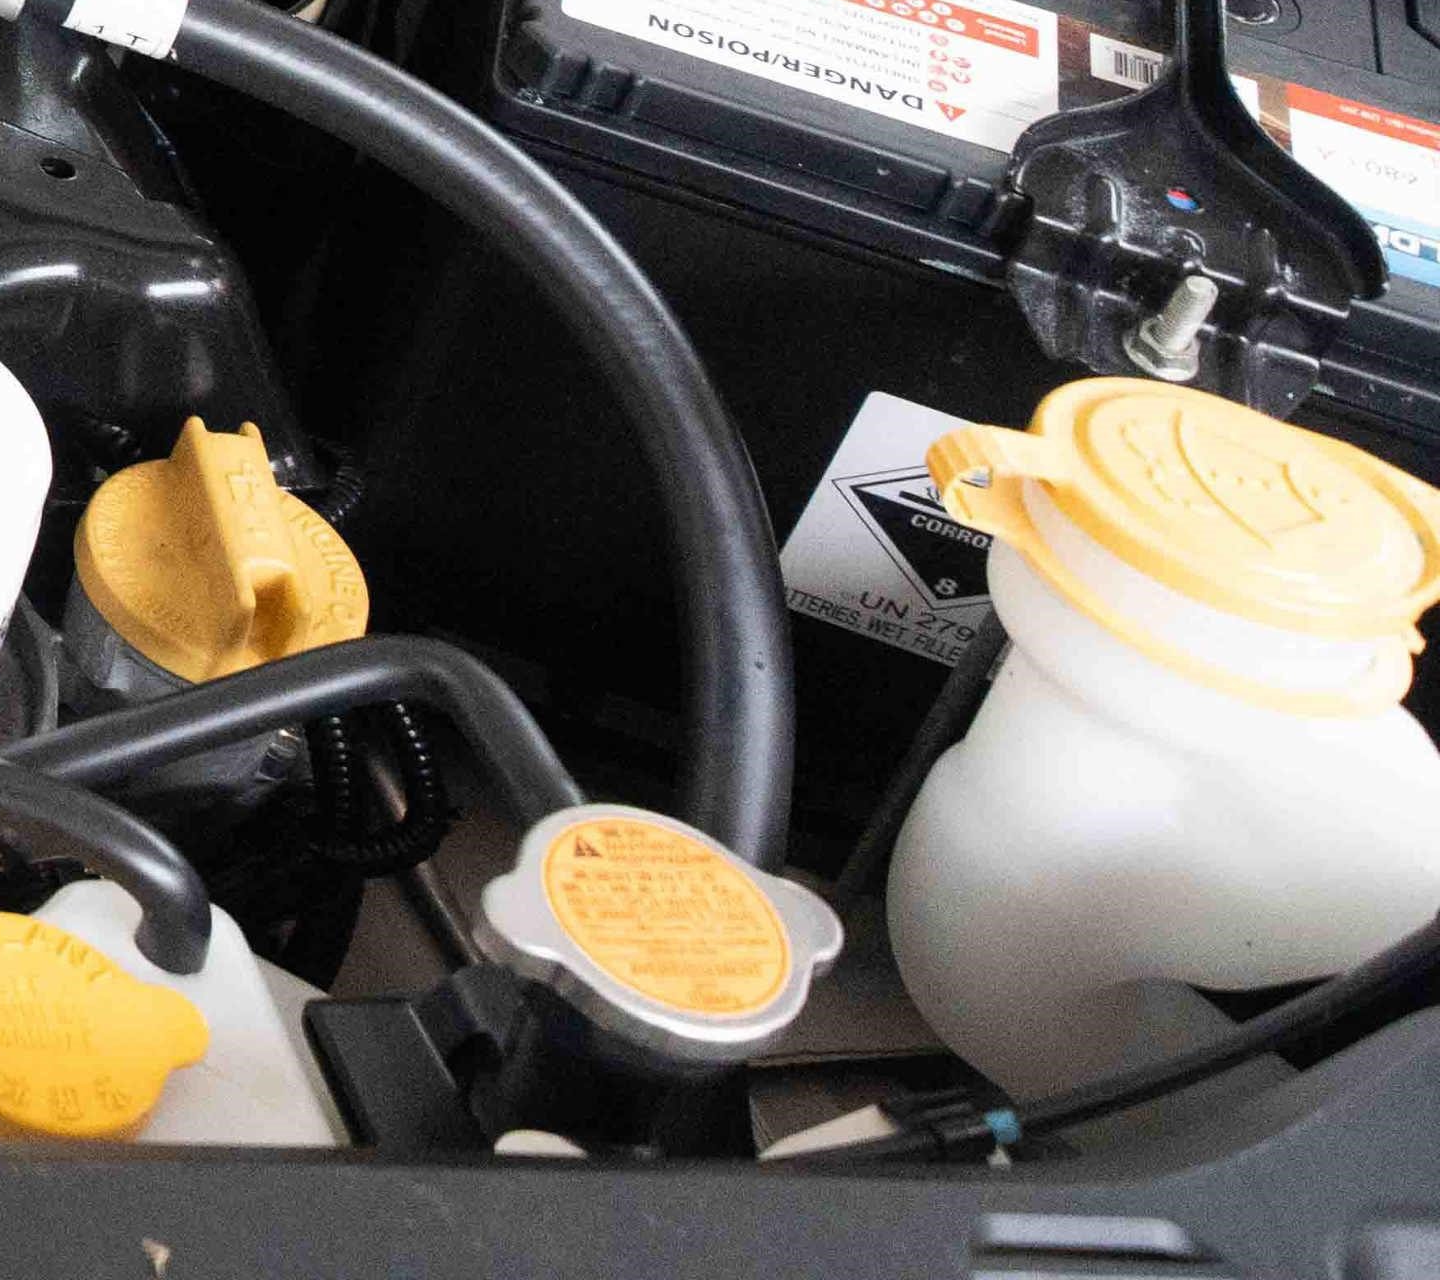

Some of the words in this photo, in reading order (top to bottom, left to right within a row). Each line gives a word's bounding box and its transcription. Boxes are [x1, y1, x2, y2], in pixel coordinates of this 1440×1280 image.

[647, 12, 924, 112] DANGER/POISON
[910, 513, 992, 550] CORRO
[933, 578, 958, 596] 8
[860, 590, 910, 620] UN
